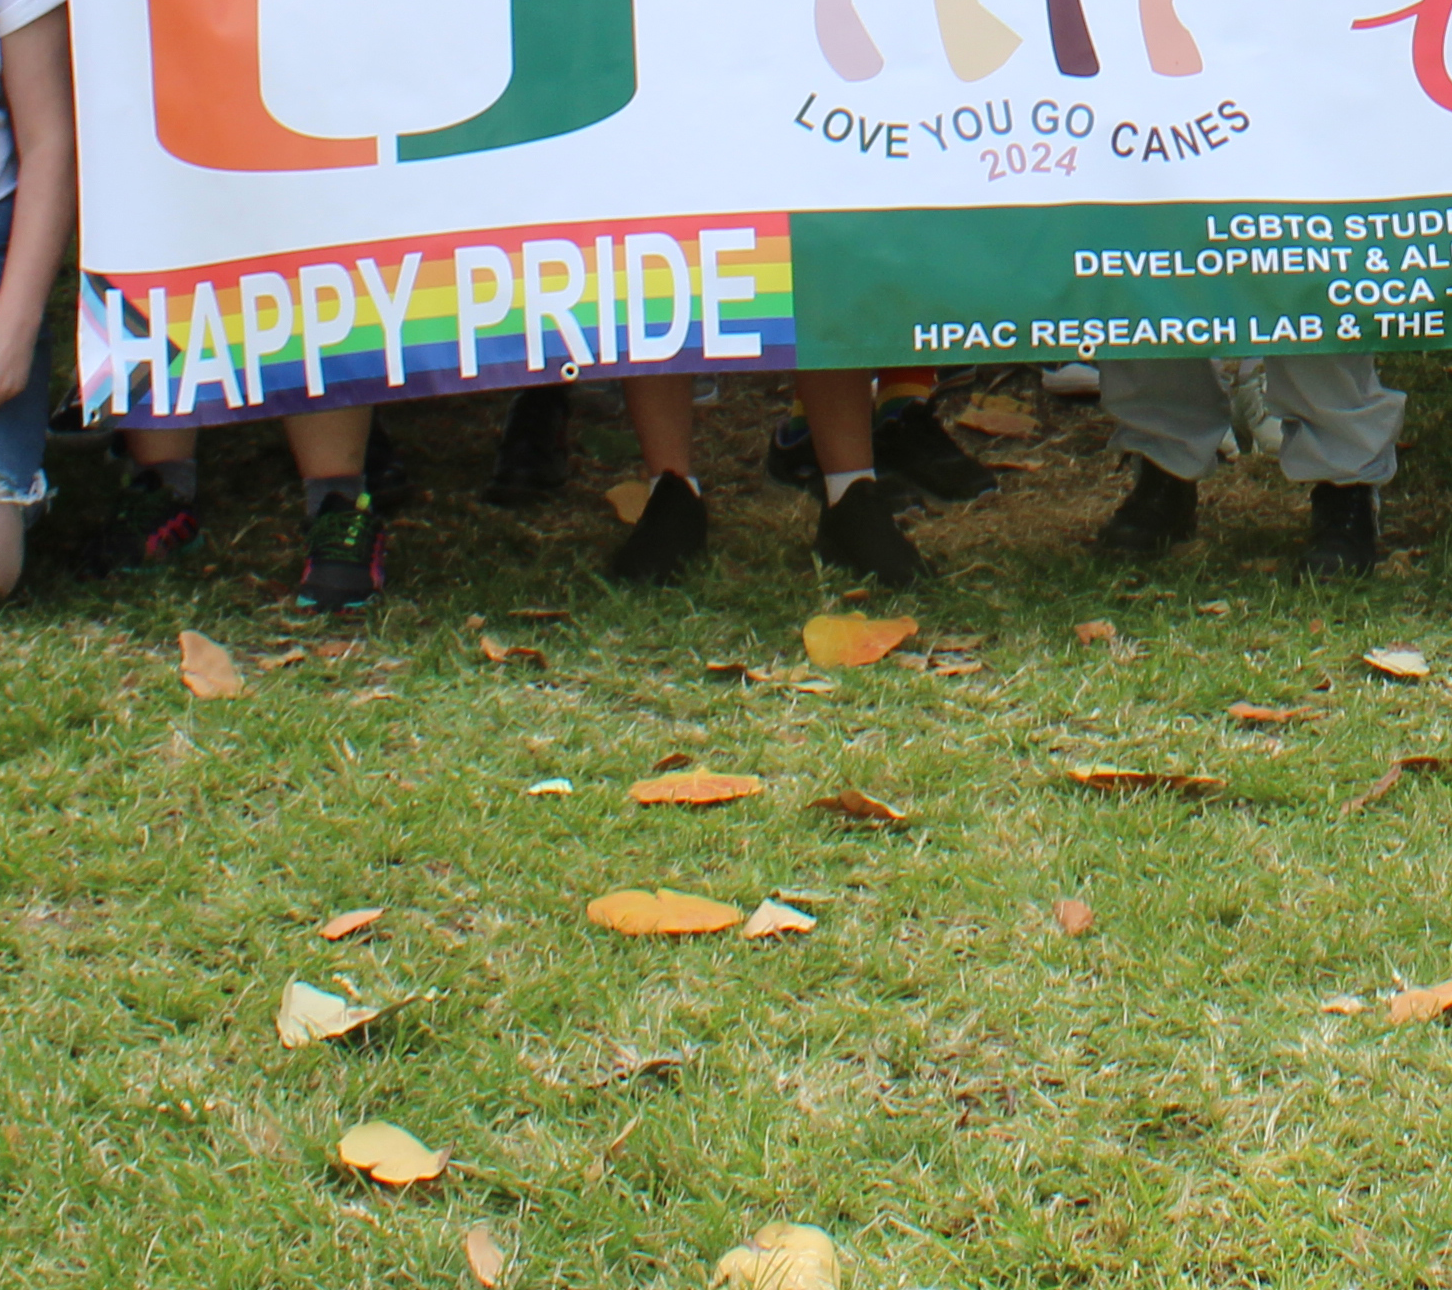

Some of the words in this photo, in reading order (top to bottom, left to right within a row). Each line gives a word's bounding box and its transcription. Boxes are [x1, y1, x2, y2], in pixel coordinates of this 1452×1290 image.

[794, 93, 909, 159] LOVE
[920, 99, 1013, 151] YOU
[1031, 101, 1094, 138] GO
[1110, 100, 1250, 162] CANES
[980, 143, 1078, 182] 2024
[1206, 214, 1334, 241] LGBTQ
[1074, 248, 1353, 277] DEVELOPMENT
[1364, 248, 1391, 274] &
[1327, 278, 1435, 307] COCA
[105, 252, 424, 417] HAPPY
[455, 228, 762, 378] PRIDE
[913, 321, 1018, 351] HPAC
[1030, 316, 1236, 348] RESEARCH
[1249, 314, 1324, 343] LAB
[1336, 313, 1362, 340] &
[1374, 310, 1446, 338] THE
